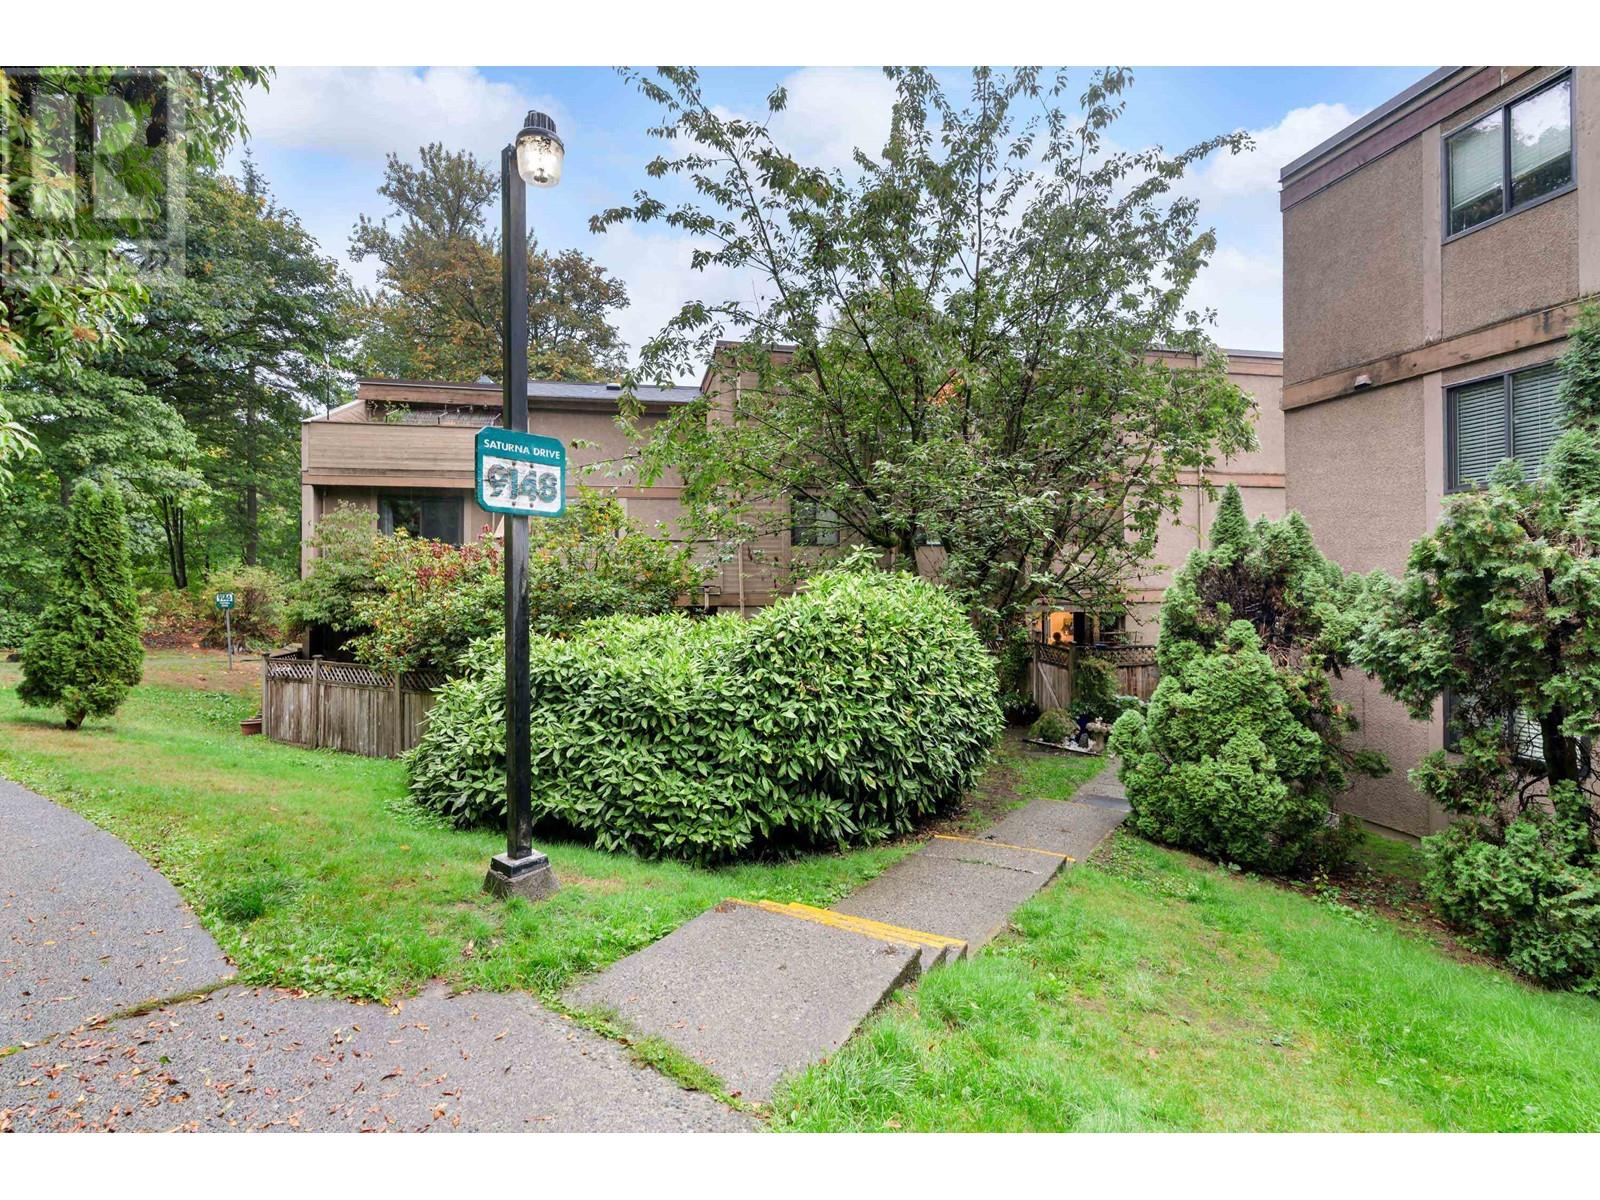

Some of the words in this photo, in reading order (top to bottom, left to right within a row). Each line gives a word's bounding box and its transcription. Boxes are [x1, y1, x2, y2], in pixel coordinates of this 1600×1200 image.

[483, 438, 530, 455] SATURNA
[533, 447, 560, 460] DRIVE
[487, 463, 558, 503] 9148
